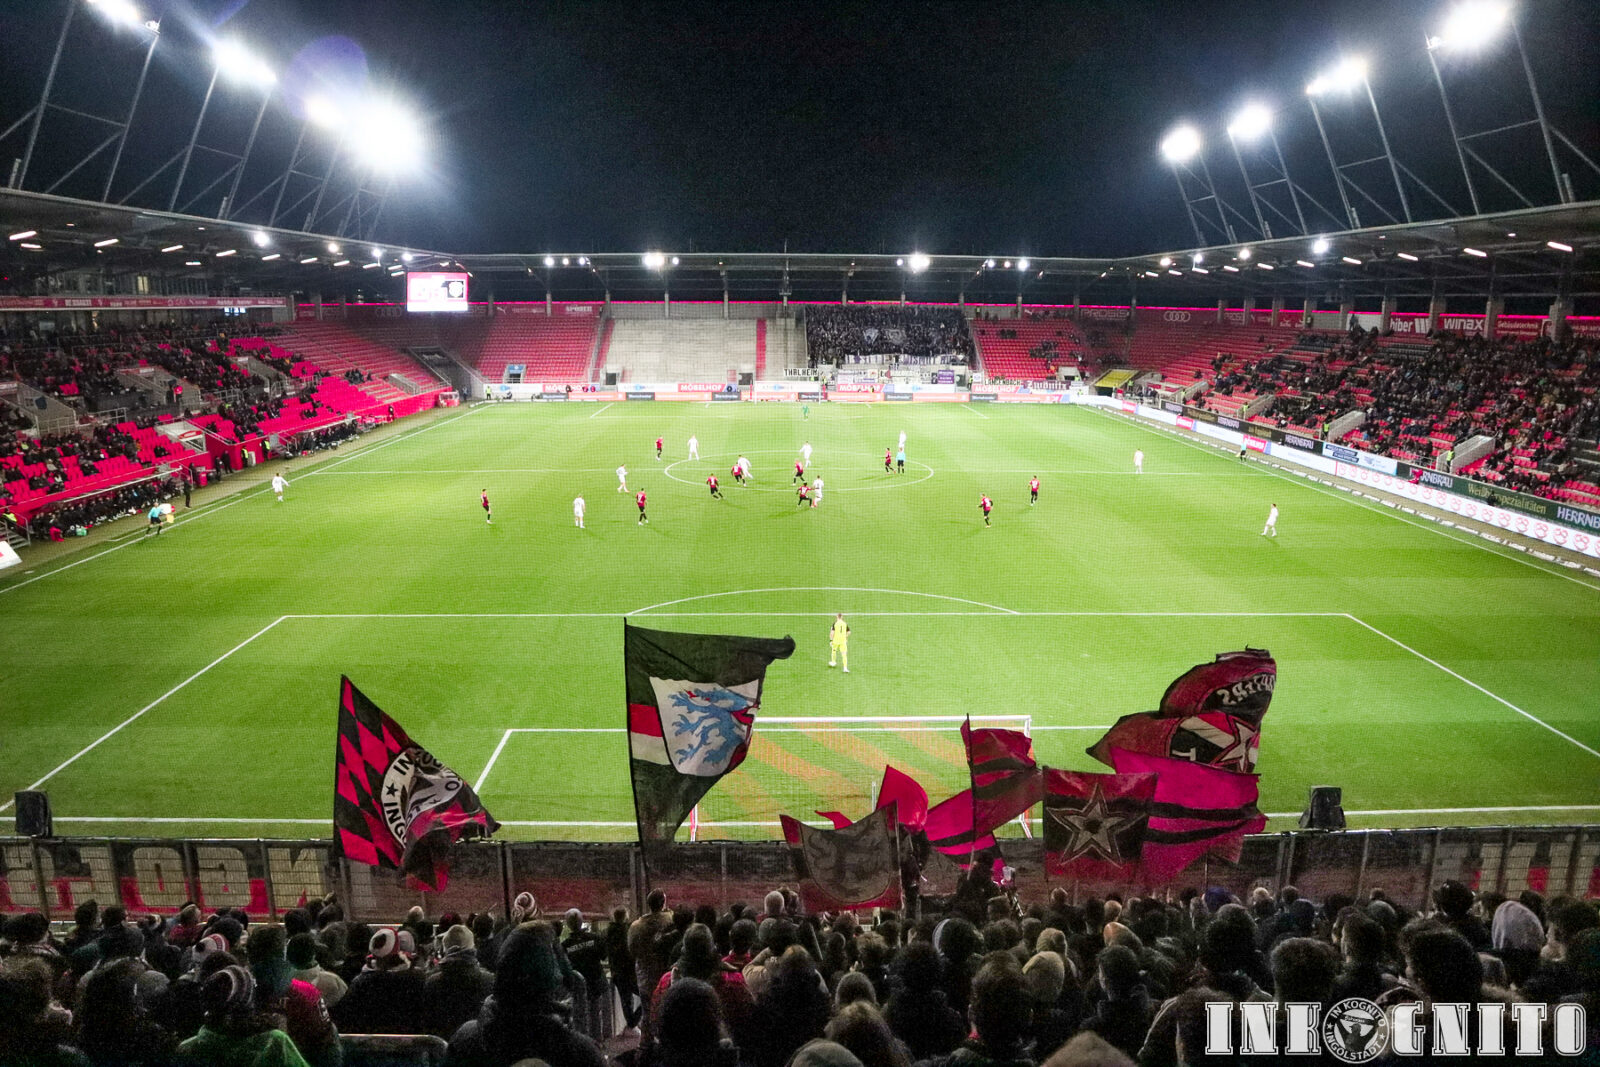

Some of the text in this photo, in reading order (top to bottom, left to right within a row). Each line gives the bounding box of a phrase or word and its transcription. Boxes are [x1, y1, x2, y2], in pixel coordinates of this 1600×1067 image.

[1444, 318, 1483, 331] winax
[784, 368, 818, 377] THALHEIM
[680, 382, 721, 391] MÖBELHOF
